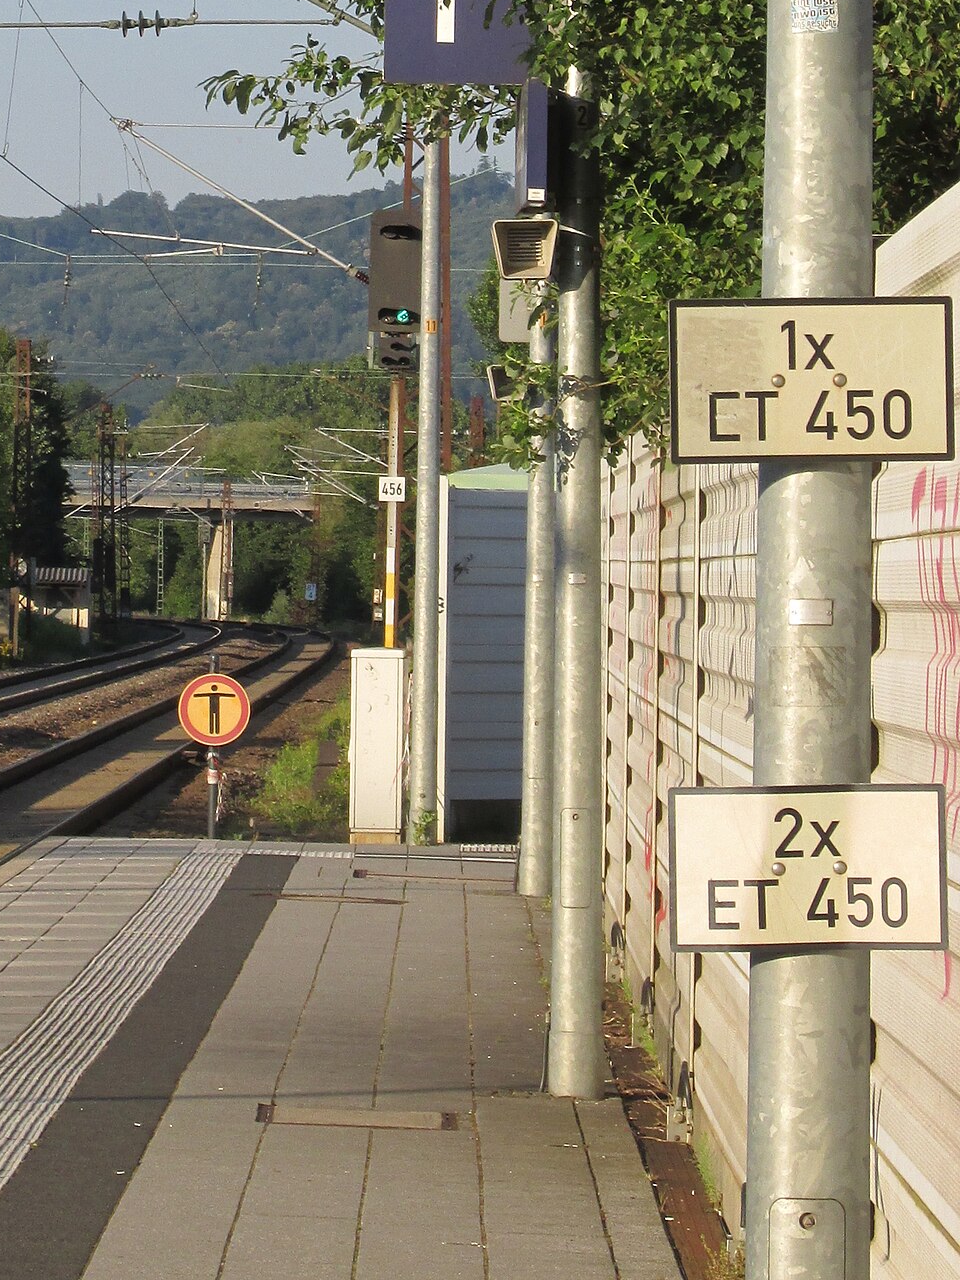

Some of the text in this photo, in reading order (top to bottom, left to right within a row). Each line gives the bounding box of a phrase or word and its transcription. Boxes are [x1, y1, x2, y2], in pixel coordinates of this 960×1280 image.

[427, 320, 436, 331] 11
[781, 320, 835, 370] 1x
[806, 389, 912, 440] 450
[382, 482, 402, 496] 456
[774, 808, 841, 858] 2x
[708, 877, 908, 930] ET 450
